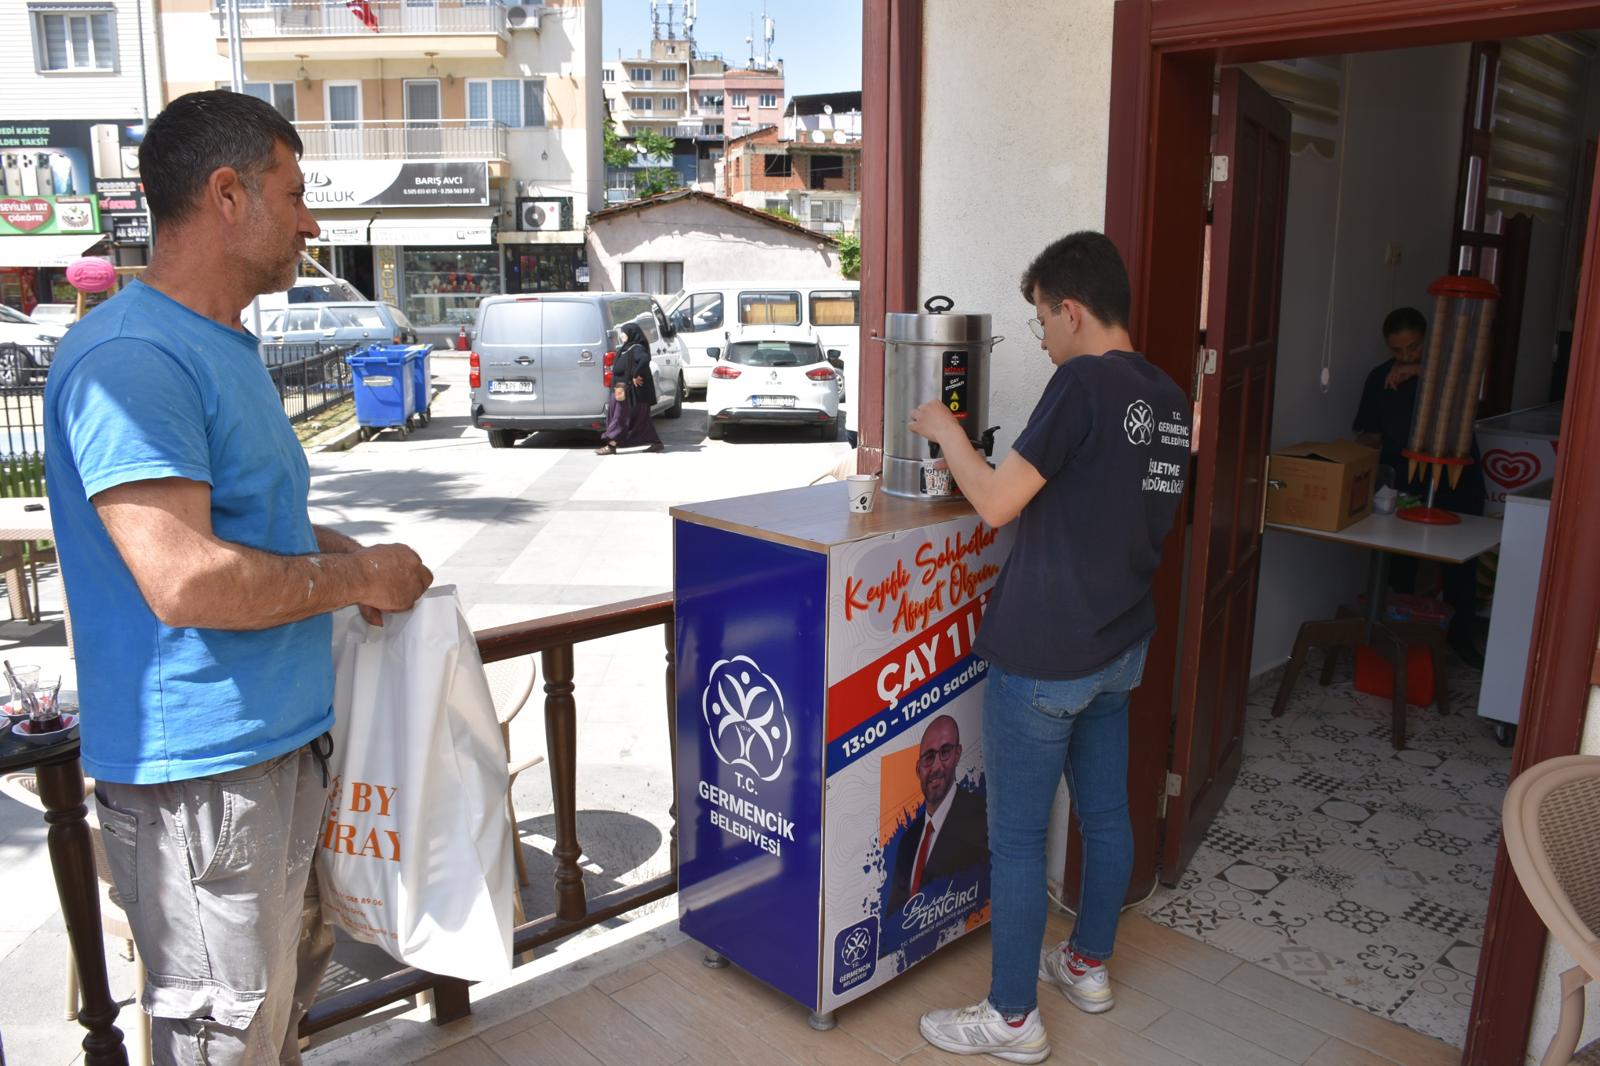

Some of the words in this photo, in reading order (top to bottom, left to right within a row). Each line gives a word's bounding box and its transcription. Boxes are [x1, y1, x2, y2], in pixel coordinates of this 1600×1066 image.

[16, 127, 50, 135] KARTSIZ
[21, 136, 48, 146] TAKSİT
[415, 177, 441, 186] BARIŞ
[443, 177, 463, 185] AVCI
[34, 203, 48, 212] TAT
[306, 191, 355, 203] CULUK
[1172, 411, 1182, 420] T.C.
[1148, 458, 1180, 476] İŞLETME
[845, 559, 910, 621] Keyifli
[915, 522, 999, 585] Sohbetler
[892, 579, 947, 634] Afiyet
[950, 561, 1000, 606] Olsun
[877, 634, 940, 710] ÇAY
[947, 622, 961, 658] 1
[842, 720, 887, 758] 13:00
[902, 686, 940, 722] 17:00
[734, 771, 758, 796] T.C.
[349, 782, 398, 817] BY
[699, 780, 795, 842] GERMENCİK
[320, 810, 401, 862] İRAY
[710, 810, 781, 857] BELEDİYESİ
[902, 880, 956, 929] Burak
[840, 962, 871, 983] GERMENCİK
